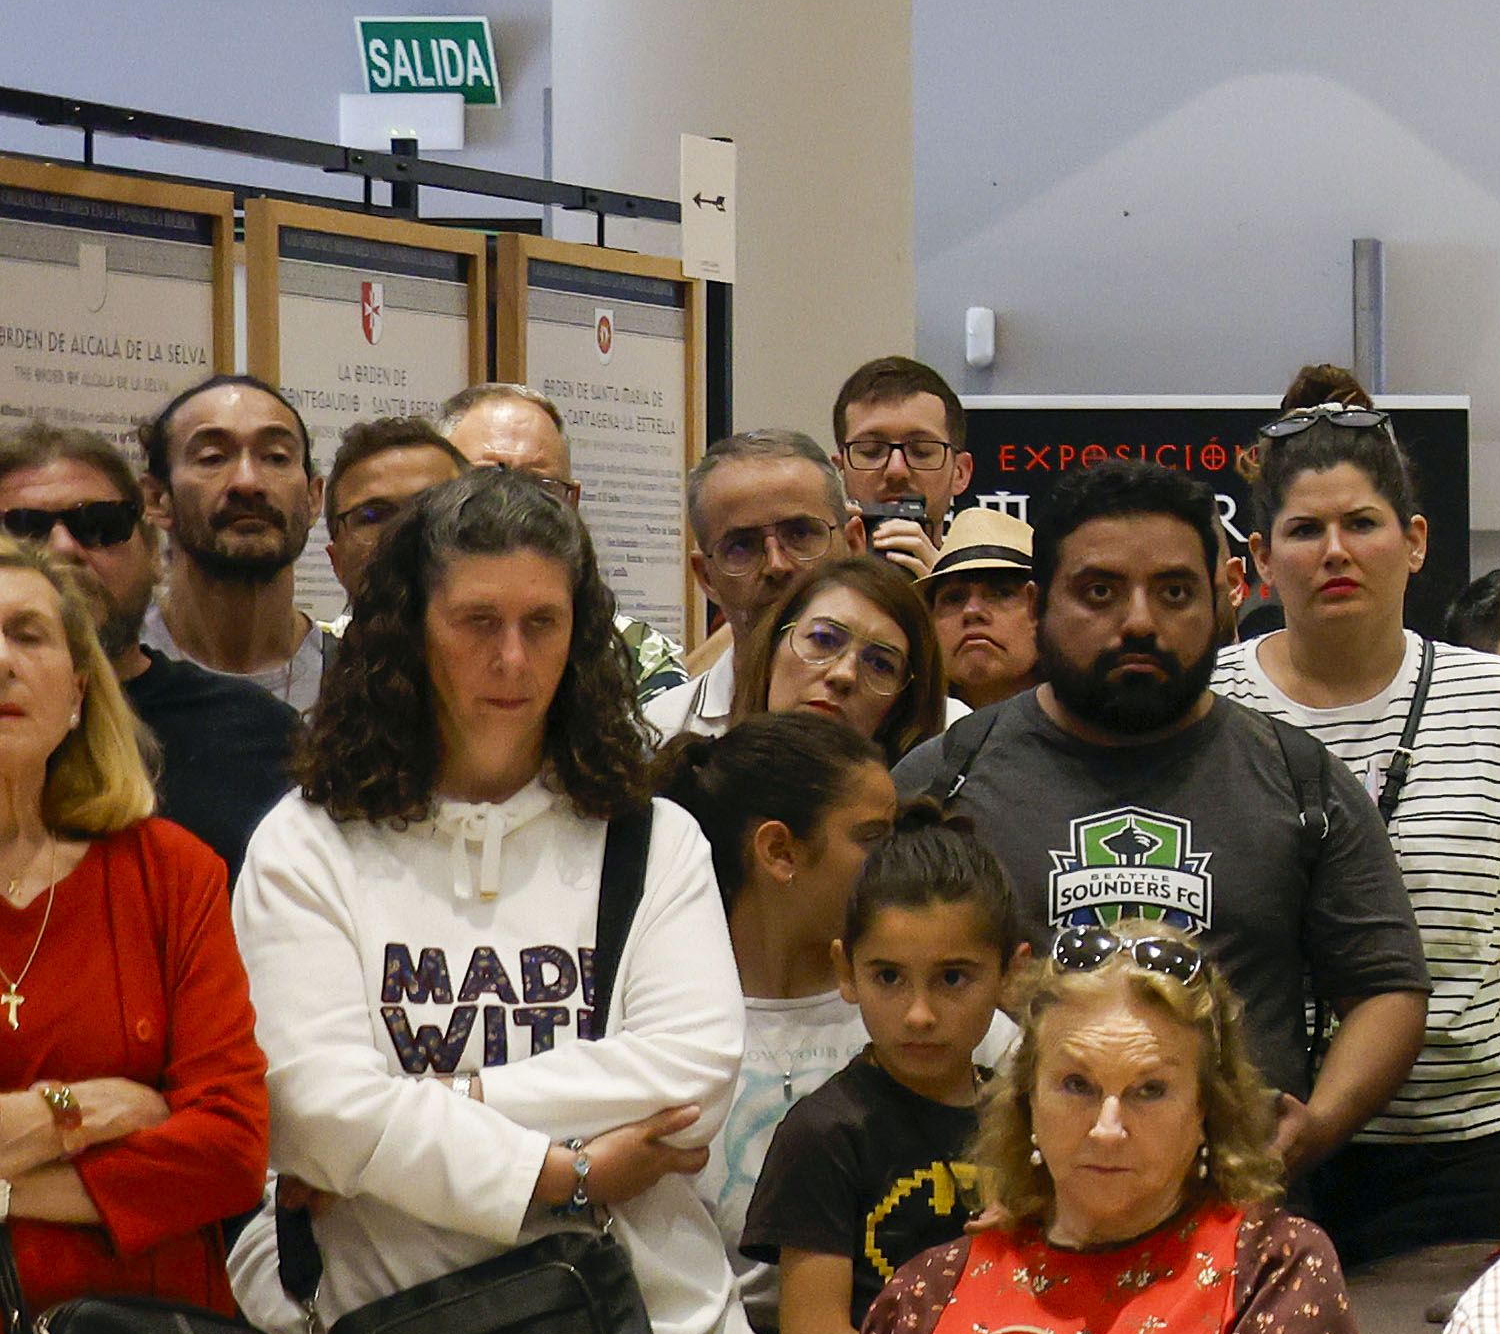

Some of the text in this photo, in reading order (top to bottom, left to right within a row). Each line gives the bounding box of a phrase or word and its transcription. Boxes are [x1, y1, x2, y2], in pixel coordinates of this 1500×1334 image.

[367, 38, 491, 90] SALIDA
[48, 331, 65, 352] DE
[126, 339, 142, 360] DE
[148, 343, 163, 362] LA
[168, 342, 207, 365] SELVA
[337, 363, 408, 388] LA ORDEN DE
[576, 382, 589, 400] DE
[652, 390, 664, 408] DE
[1090, 872, 1170, 883] SEATTLE
[1060, 880, 1202, 910] SOUNDERS FC
